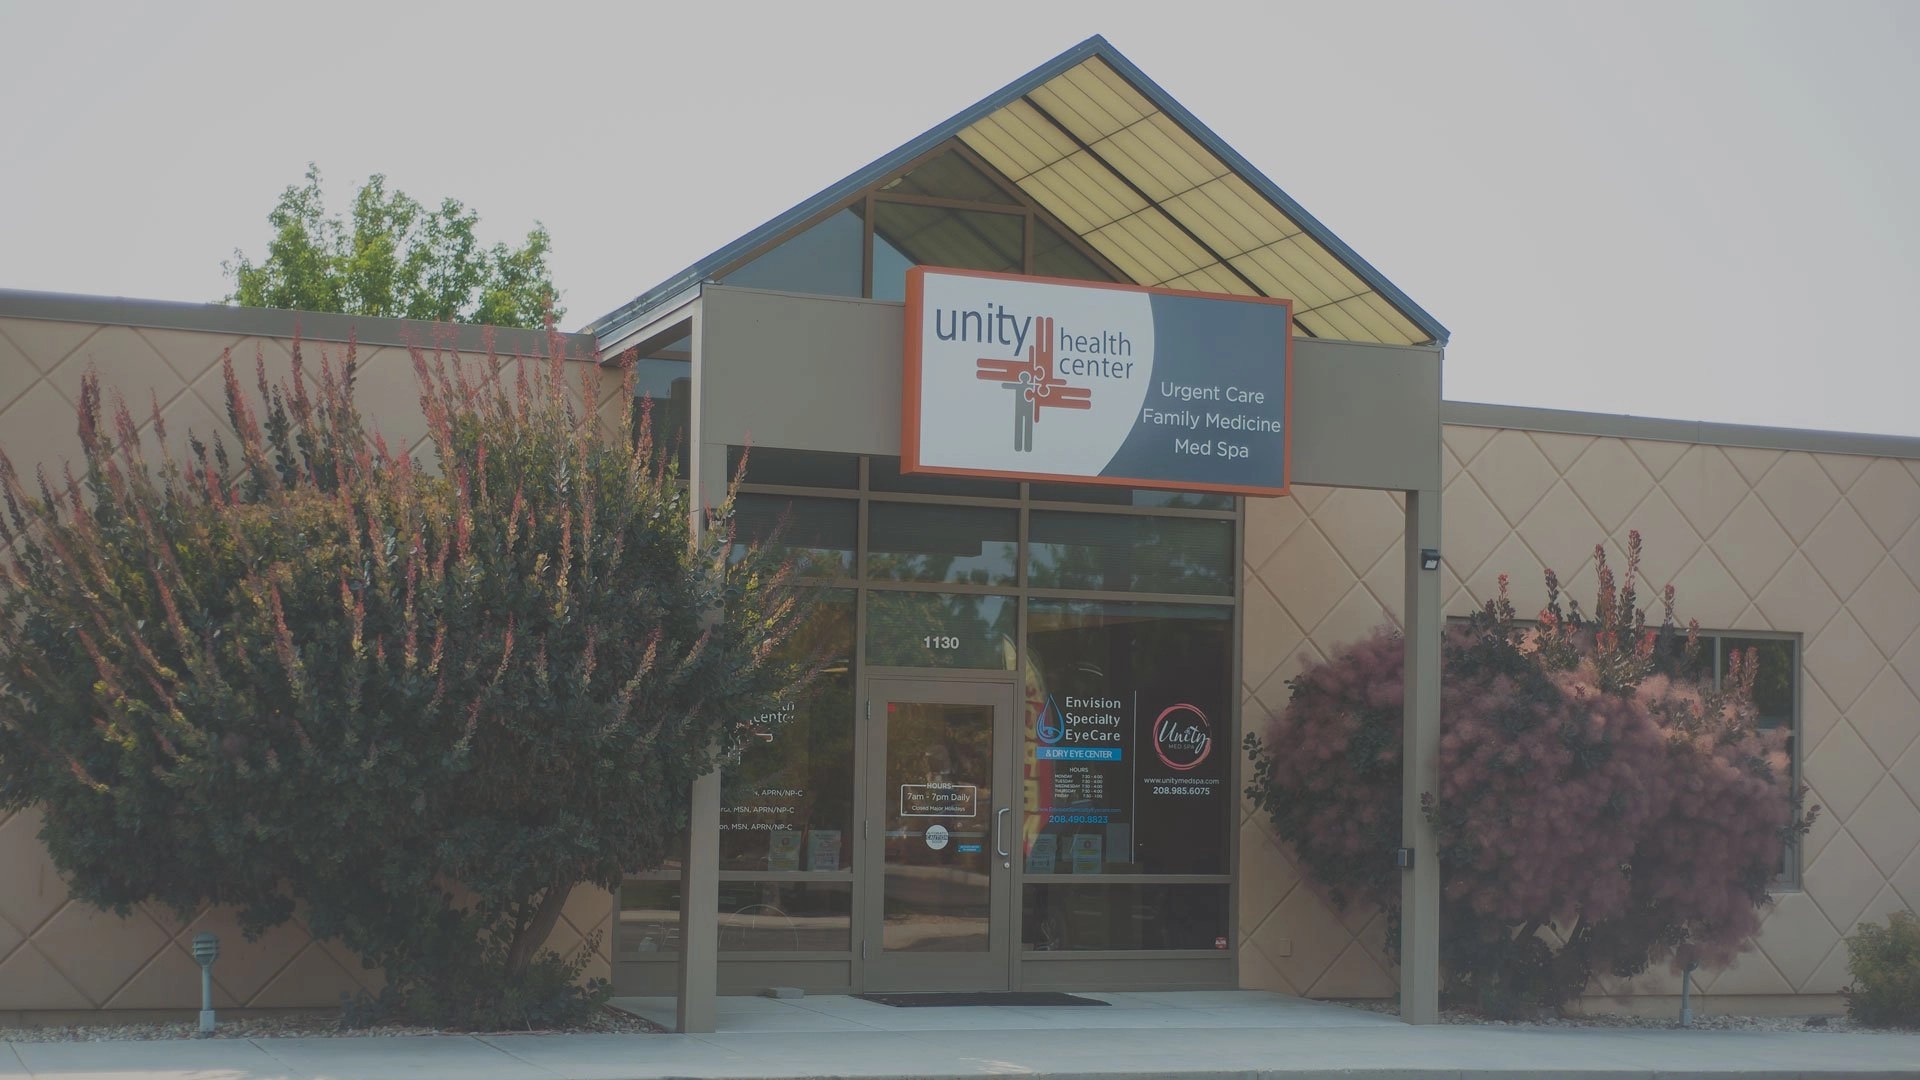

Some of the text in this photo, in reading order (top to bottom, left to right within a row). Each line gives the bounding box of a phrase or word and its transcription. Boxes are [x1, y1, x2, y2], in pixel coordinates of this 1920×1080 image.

[936, 303, 1031, 356] unity
[1060, 327, 1131, 356] health
[1059, 357, 1133, 379] center
[1161, 381, 1264, 404] Urgent Care
[1143, 408, 1281, 433] Family Medicine
[1175, 439, 1249, 460] Med Spa
[924, 636, 960, 649] 1130
[1066, 696, 1121, 709] Envision
[1066, 712, 1121, 727] Specialty
[1065, 729, 1121, 742] EyeCare
[1159, 720, 1207, 754] Unity
[1053, 750, 1069, 758] DRY
[1070, 750, 1084, 758] EYE
[1084, 750, 1113, 759] CENTER
[1144, 777, 1220, 785] www.unitymedspa.com
[907, 793, 924, 801] 7am
[932, 793, 949, 802] 7pm
[951, 793, 970, 802] Daily
[1153, 786, 1210, 795] 208.985.6075
